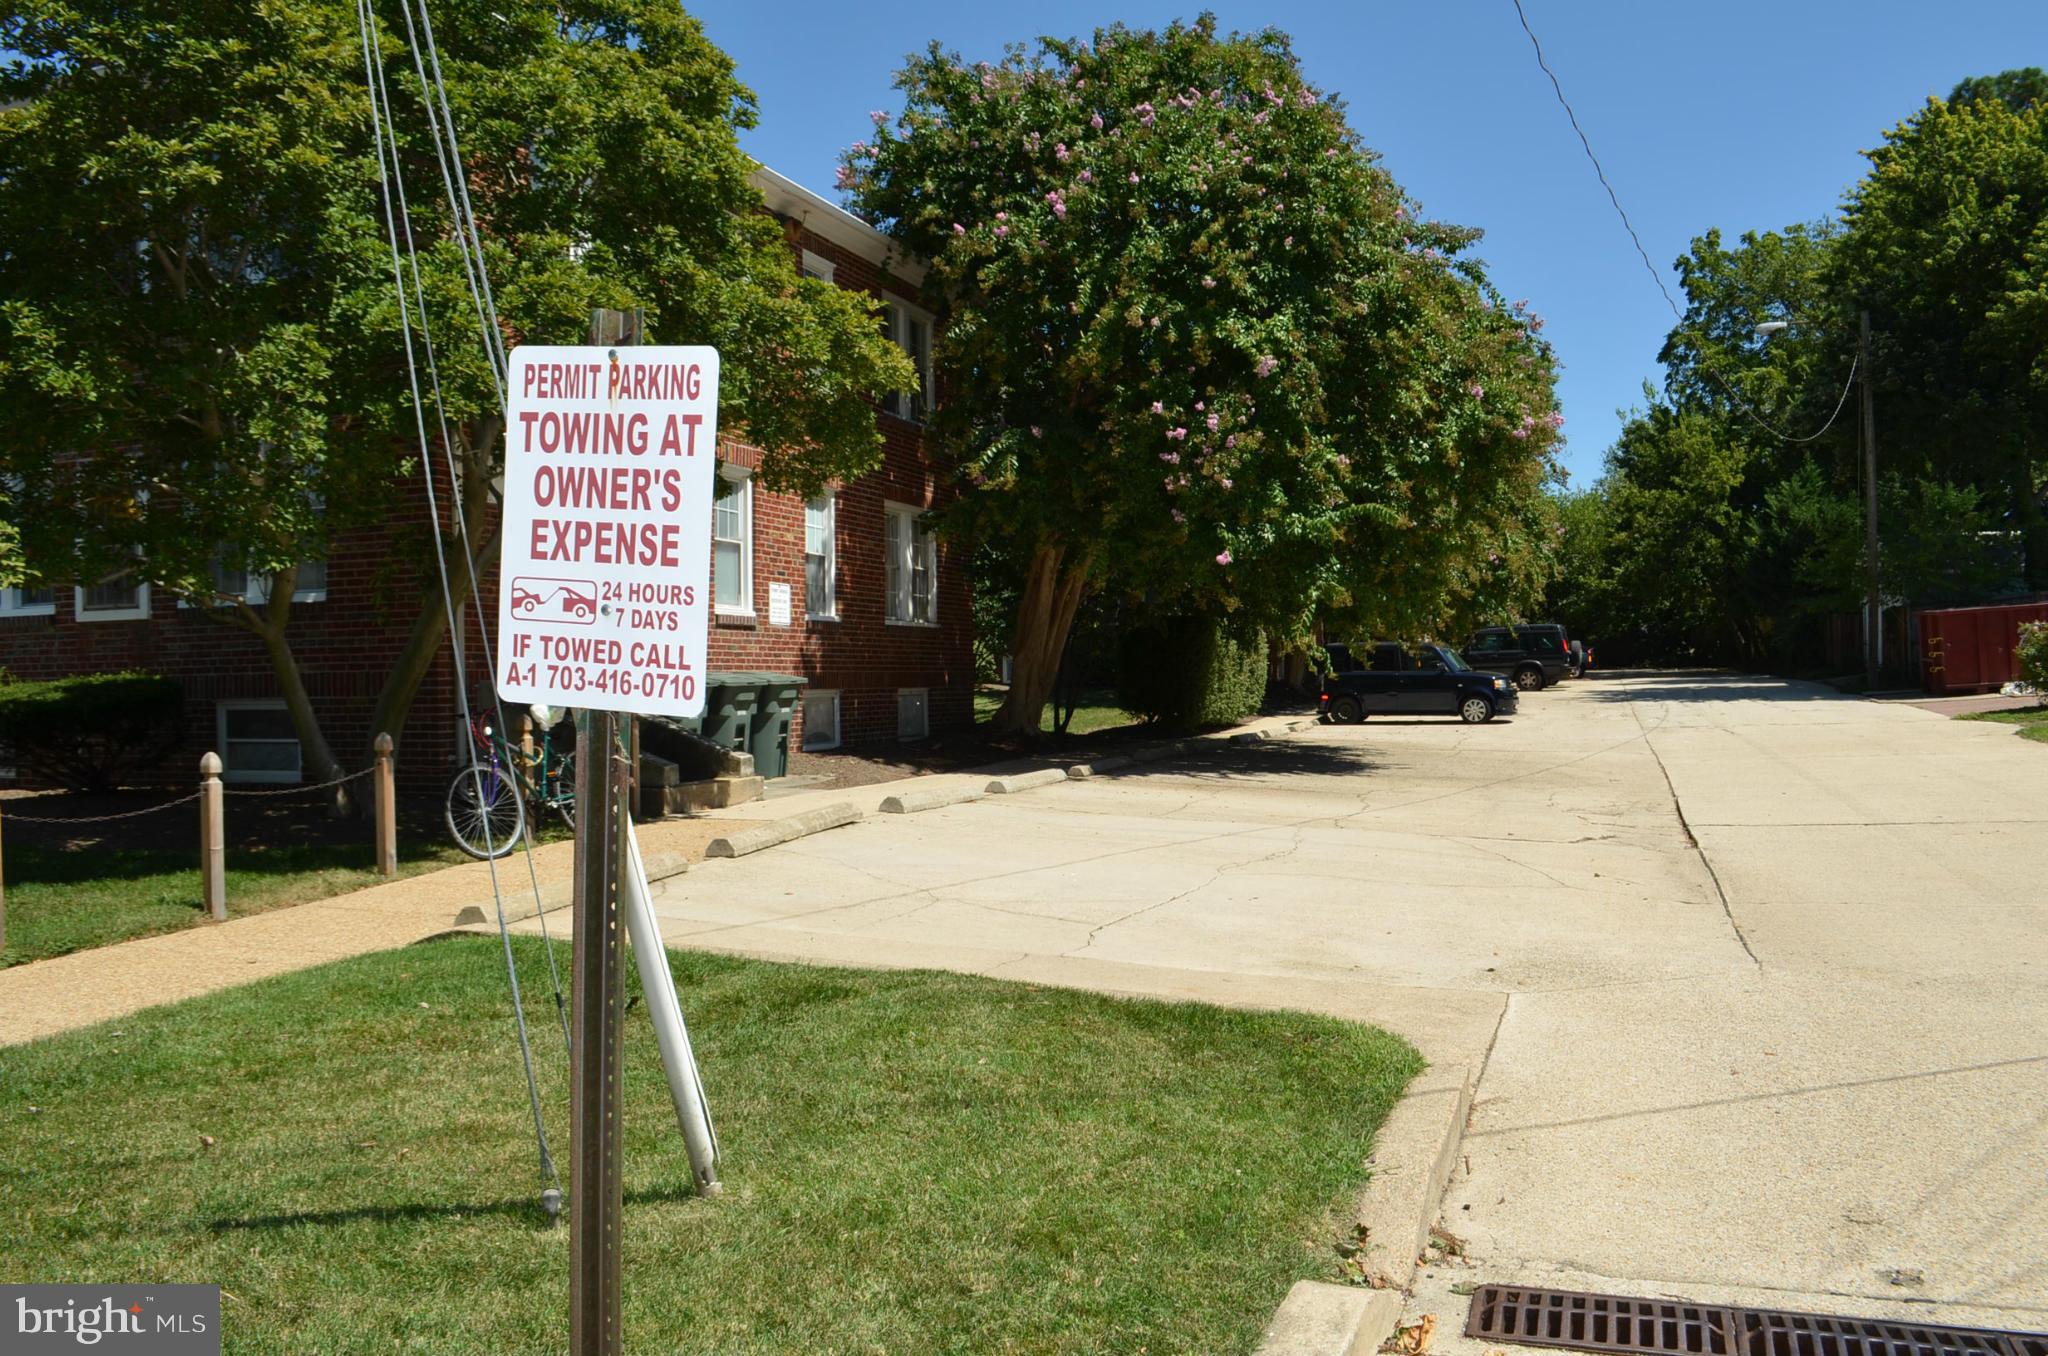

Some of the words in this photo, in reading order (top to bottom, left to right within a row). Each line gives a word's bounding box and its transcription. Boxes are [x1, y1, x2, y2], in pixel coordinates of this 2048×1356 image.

[524, 364, 601, 400] PERMIT
[608, 364, 700, 401] PARKING
[520, 412, 648, 455] TOWING
[659, 414, 702, 456] AT
[534, 465, 681, 512] OWNER'S
[530, 519, 680, 567] EXPENSE
[602, 581, 622, 601] 24
[629, 583, 694, 605] HOURS
[616, 608, 625, 627] 7
[631, 609, 678, 631] DAYS
[513, 634, 531, 658] IF
[540, 636, 622, 665] TOWED
[630, 642, 690, 671] CALL
[506, 663, 536, 687] A-1
[547, 665, 695, 700] 703-416-0710
